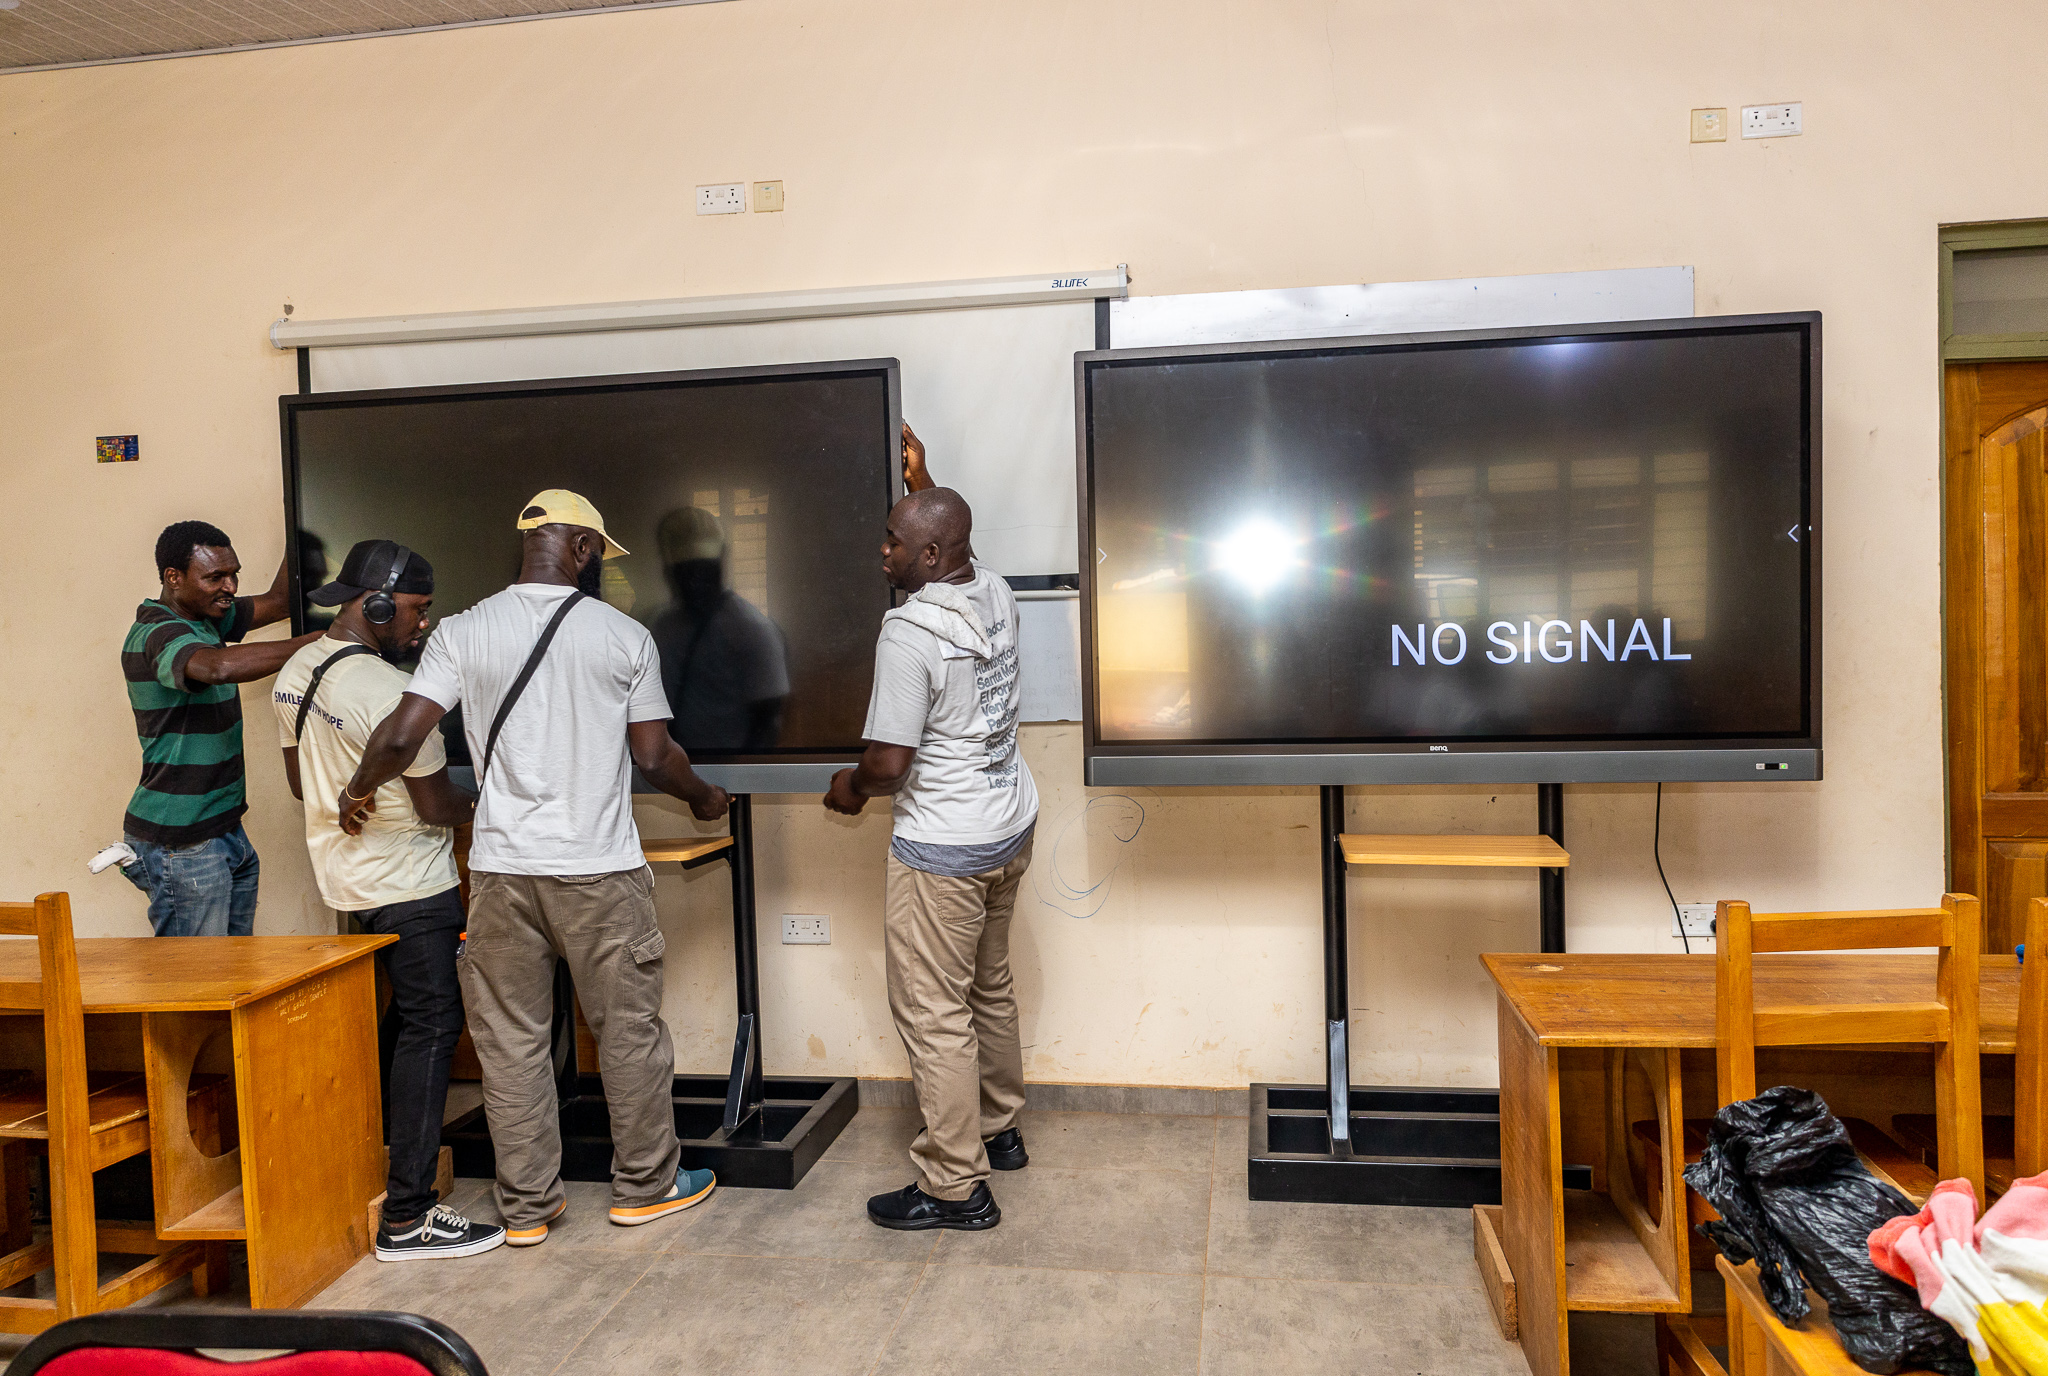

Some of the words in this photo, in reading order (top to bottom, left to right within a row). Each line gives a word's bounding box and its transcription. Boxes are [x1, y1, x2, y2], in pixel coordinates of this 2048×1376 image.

[1051, 277, 1089, 288] BLUTEK
[985, 619, 1007, 639] ador
[1391, 622, 1467, 666] NO
[1485, 617, 1692, 664] SIGNAL
[974, 646, 1017, 677] Huntington
[976, 670, 1004, 690] Santa
[980, 690, 990, 705] El
[274, 691, 304, 706] SMILE
[321, 709, 344, 730] HOPE
[988, 776, 1018, 789] Lechu
